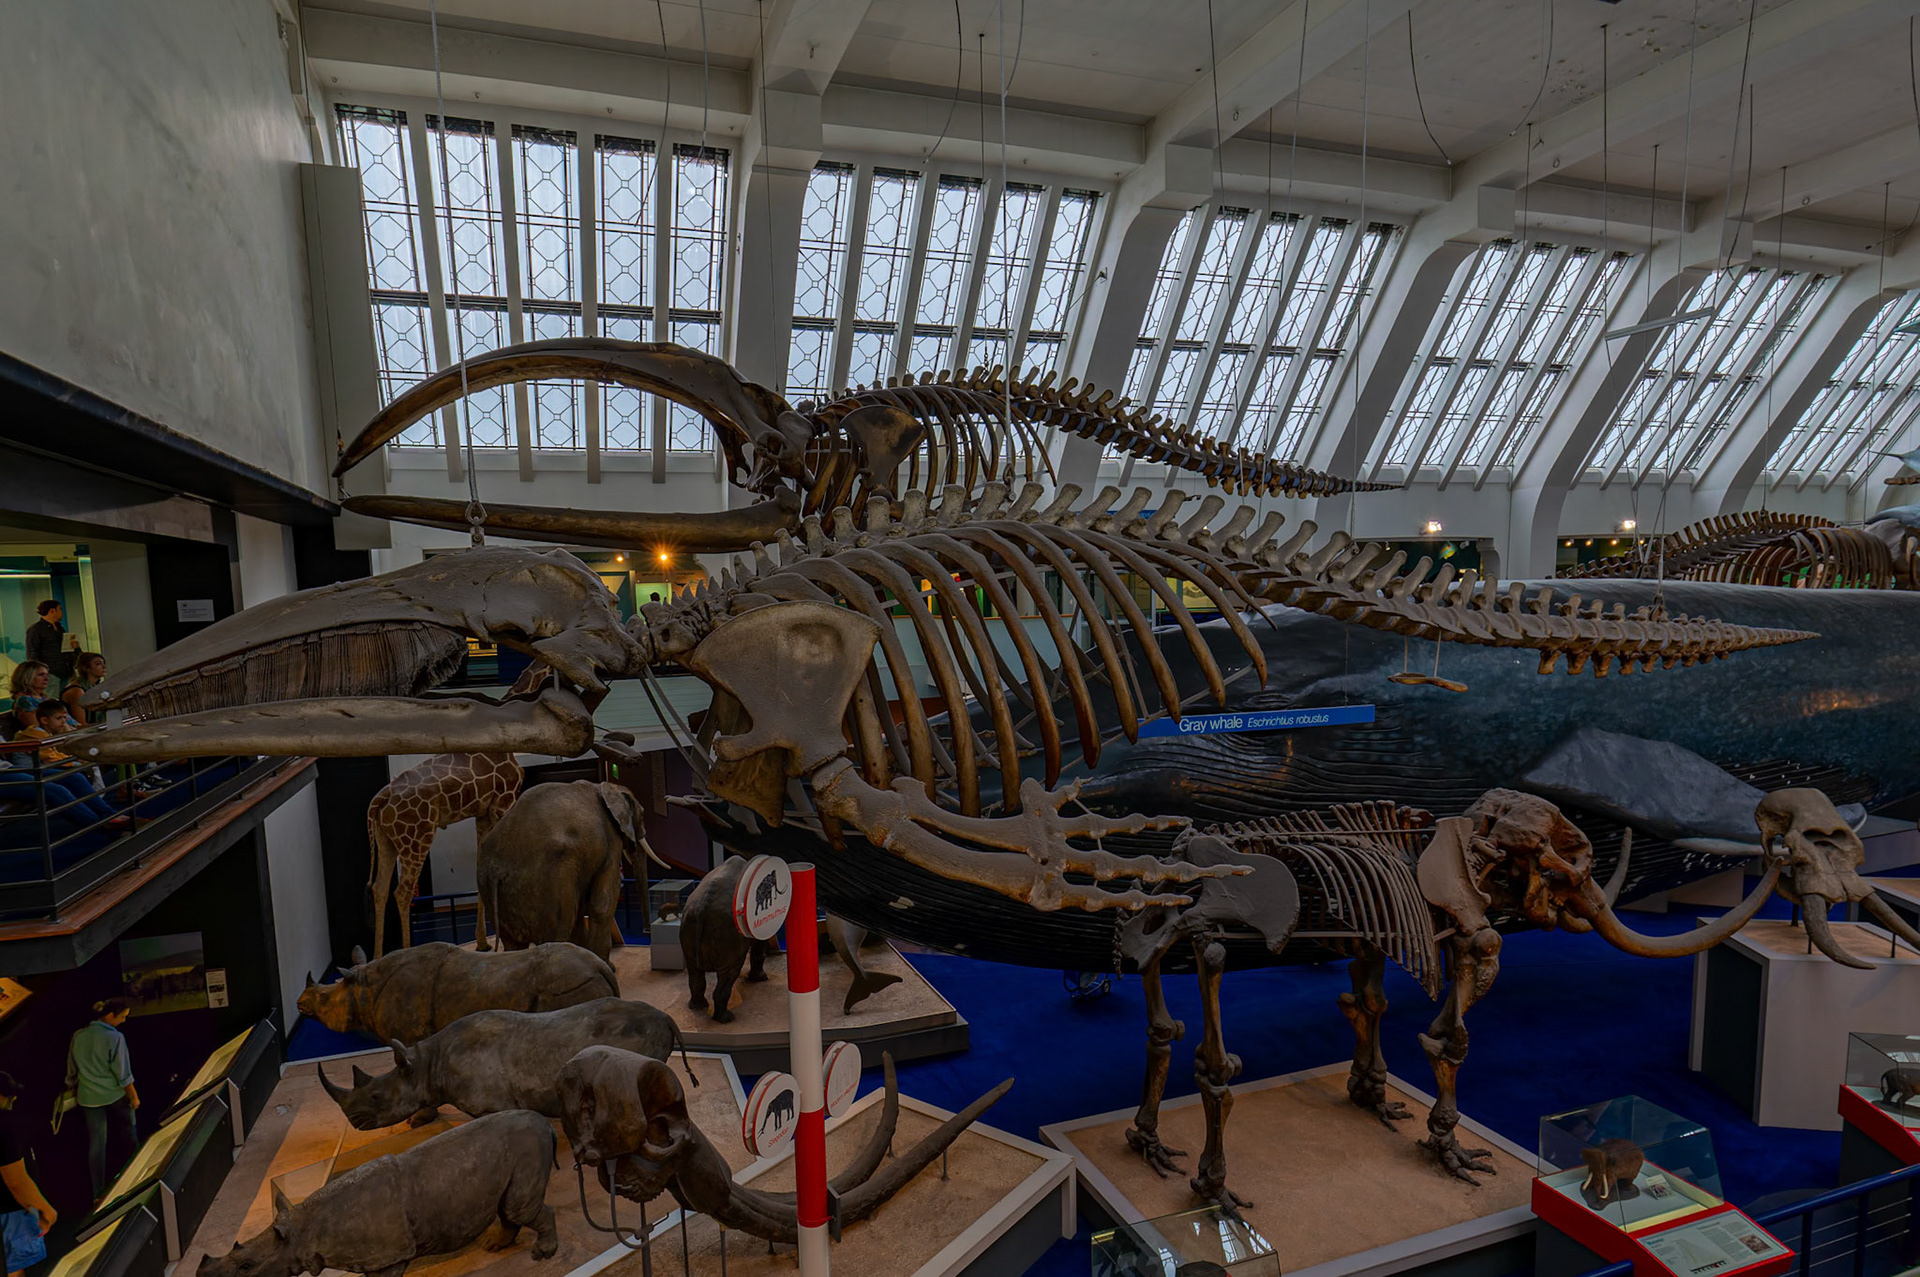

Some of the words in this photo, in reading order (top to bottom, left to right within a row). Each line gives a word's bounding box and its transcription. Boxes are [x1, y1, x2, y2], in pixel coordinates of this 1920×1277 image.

[1179, 718, 1208, 733] Gray
[1209, 716, 1243, 730] whale
[1248, 715, 1295, 728] Eschrichtius
[1296, 713, 1329, 724] robustus
